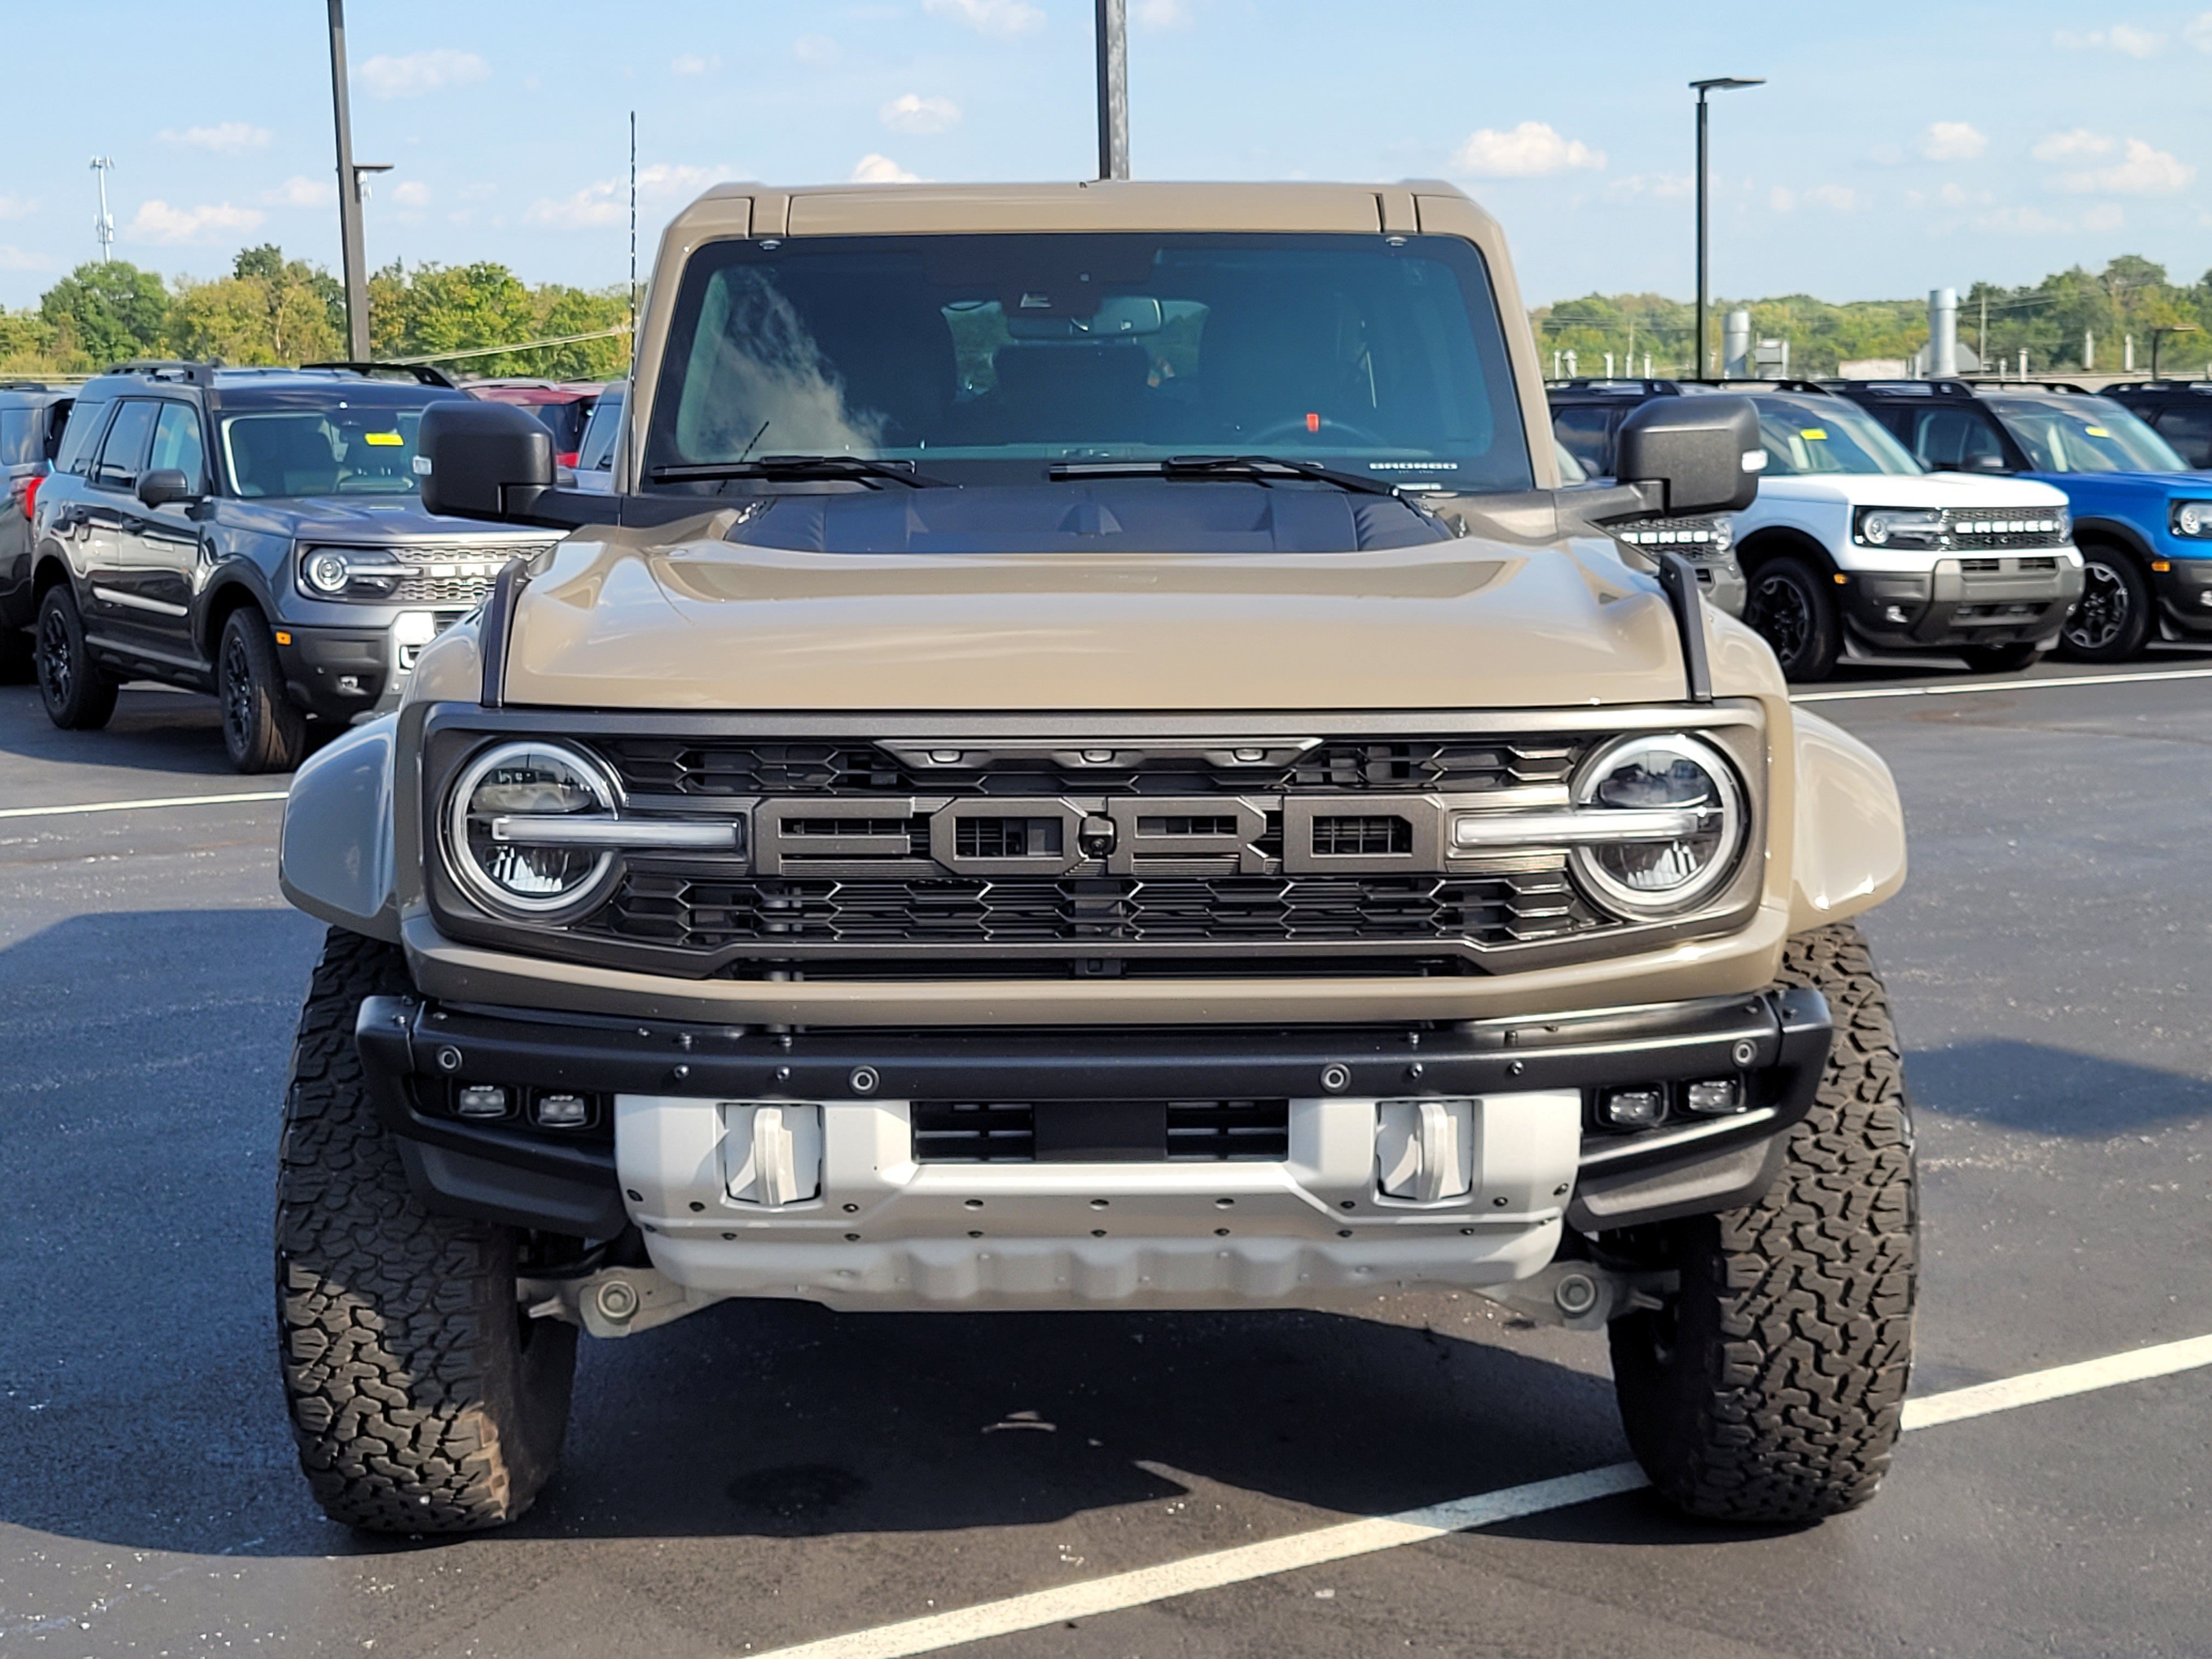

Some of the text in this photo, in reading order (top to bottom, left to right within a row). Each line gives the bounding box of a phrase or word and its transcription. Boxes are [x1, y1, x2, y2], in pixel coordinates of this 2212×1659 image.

[1955, 521, 2053, 533] BRONCO
[1620, 531, 1709, 544] RONCO
[753, 796, 1444, 875] FORD
